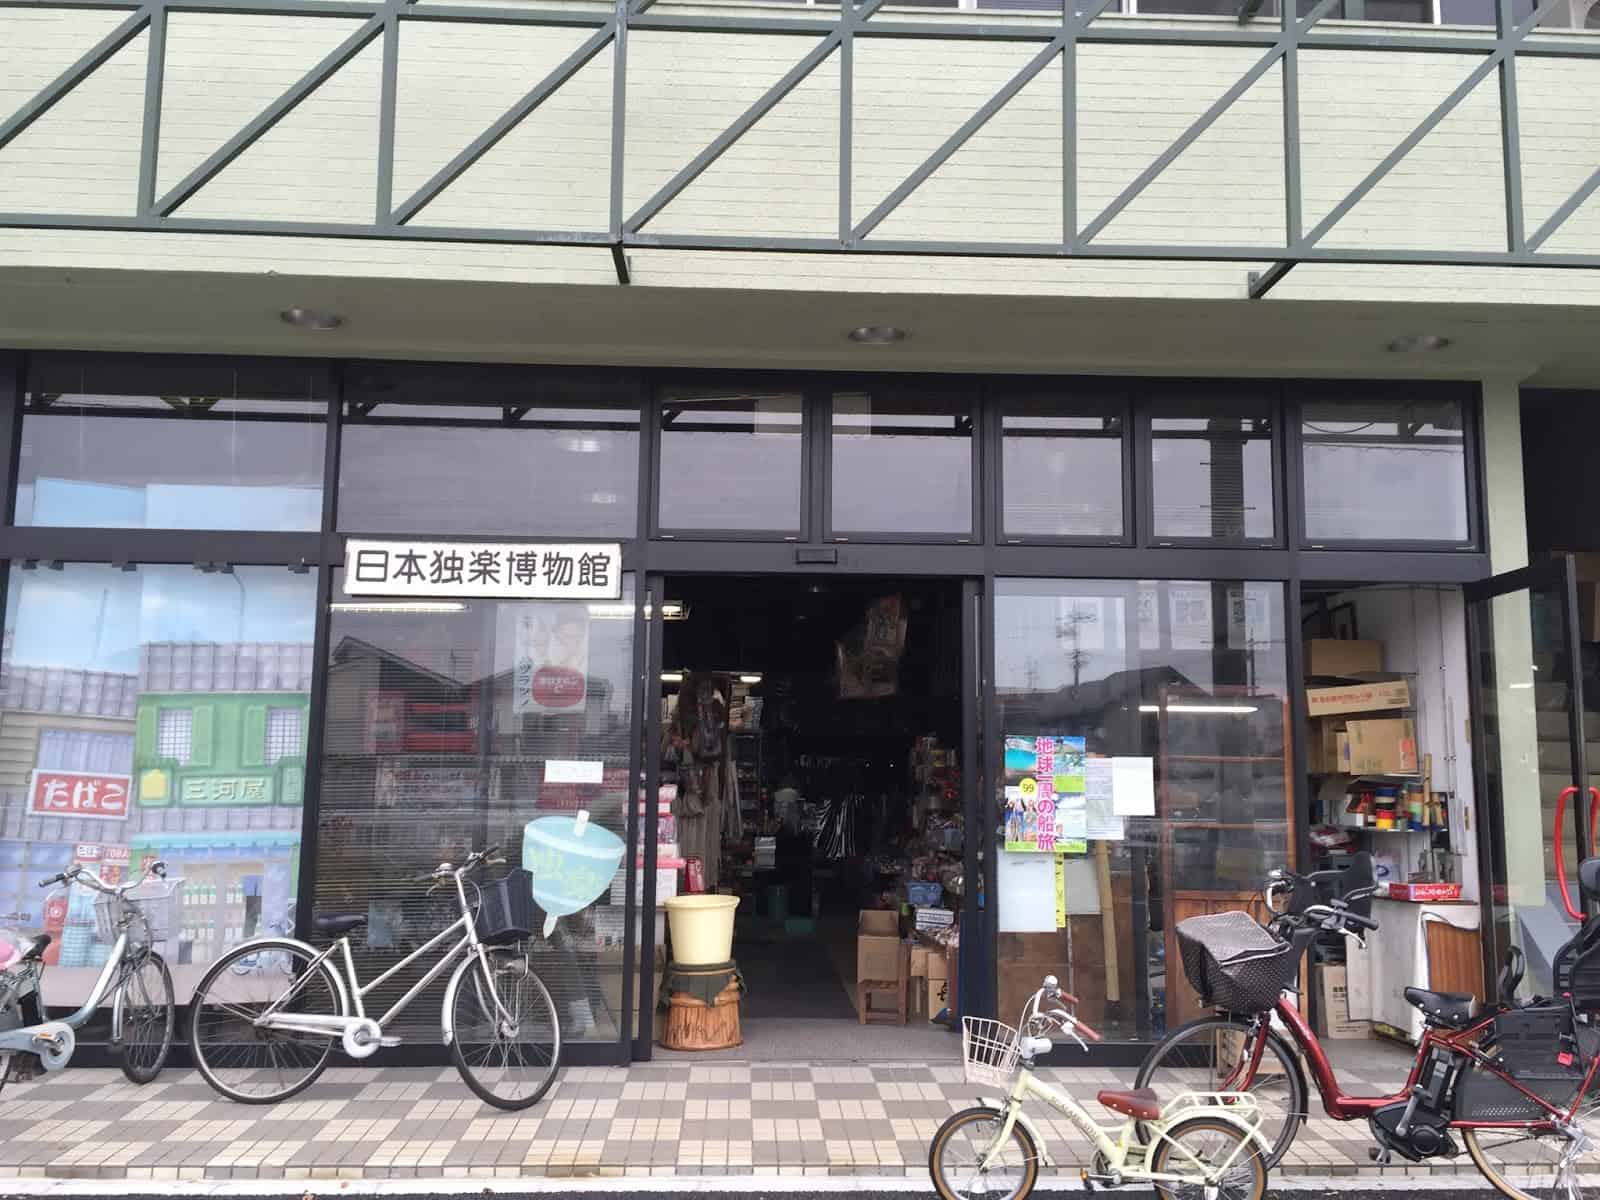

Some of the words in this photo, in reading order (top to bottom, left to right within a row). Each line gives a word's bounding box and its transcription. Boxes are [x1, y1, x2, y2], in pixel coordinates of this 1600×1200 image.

[355, 548, 611, 587] 日本独楽博物館
[42, 778, 126, 810] たばこ
[185, 778, 266, 800] 三河屋
[1036, 737, 1055, 849] 地球一周の船旅
